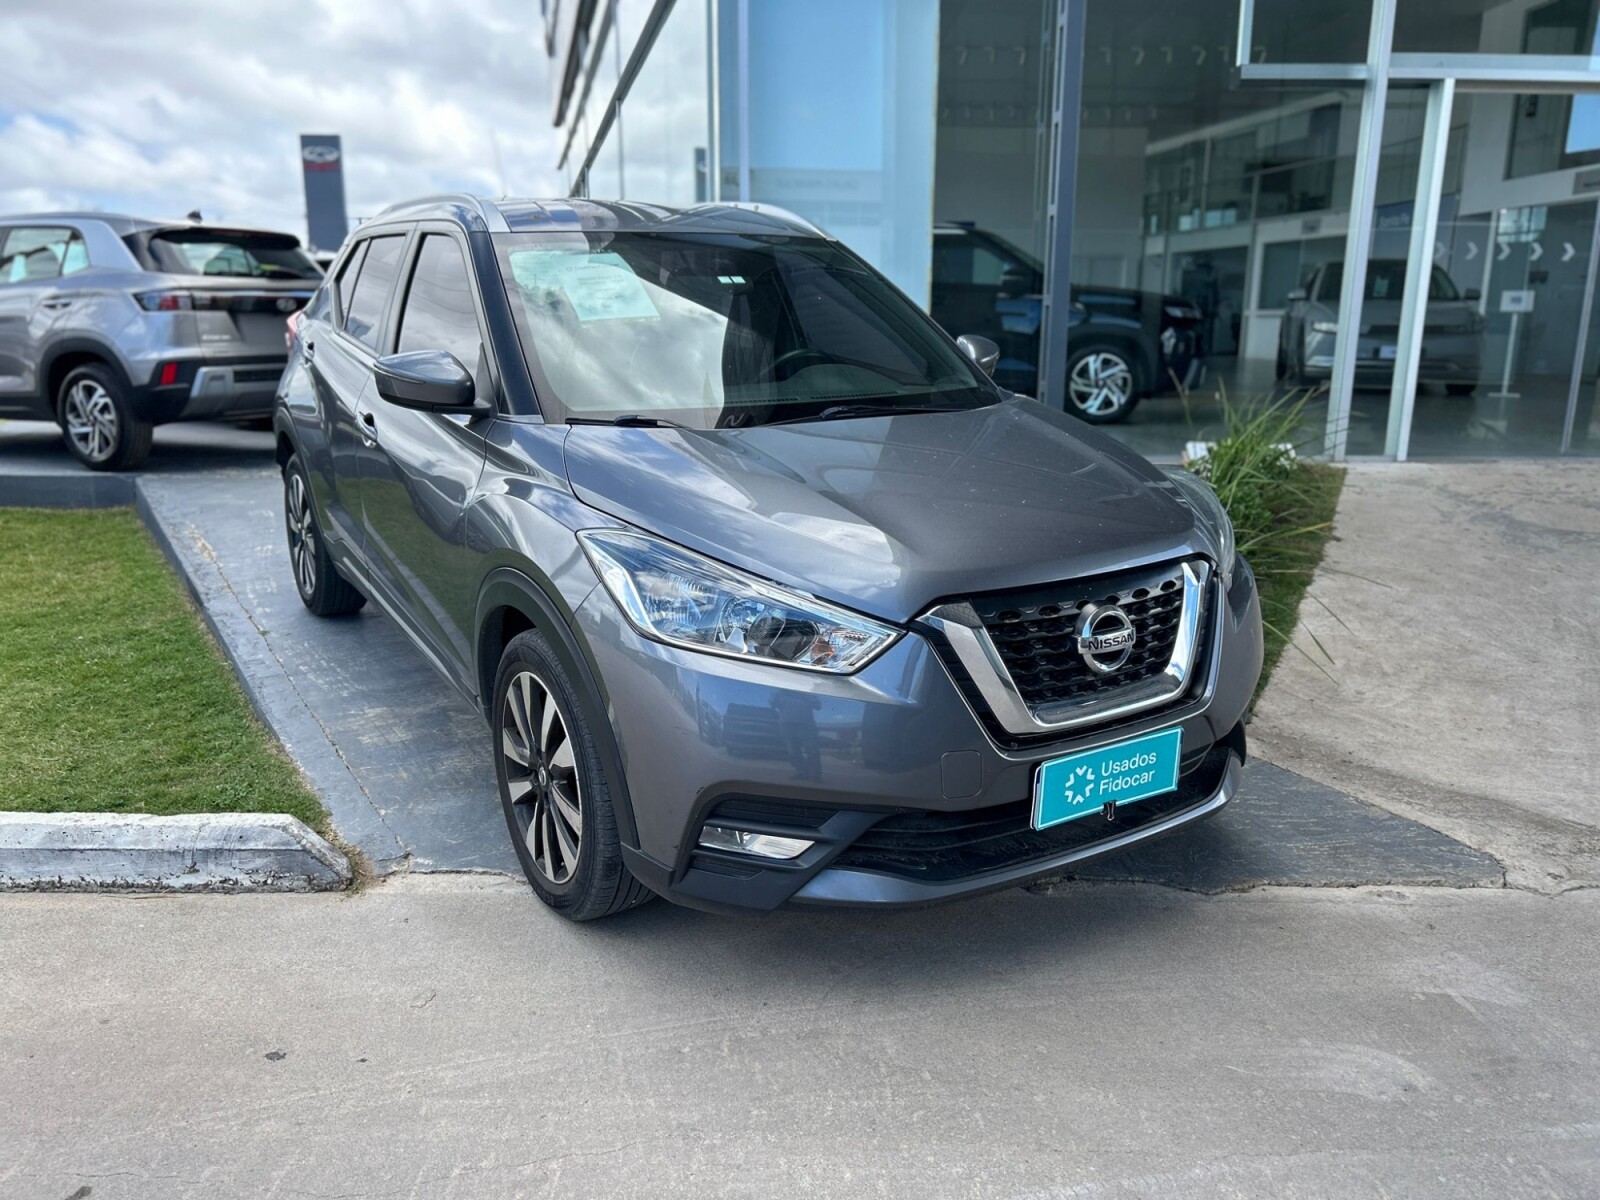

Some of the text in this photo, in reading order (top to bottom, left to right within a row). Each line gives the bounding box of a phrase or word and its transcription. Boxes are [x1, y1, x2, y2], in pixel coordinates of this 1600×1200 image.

[1088, 630, 1134, 651] NISSAN
[1101, 752, 1157, 777] Usados
[1099, 769, 1156, 795] Fidocar
